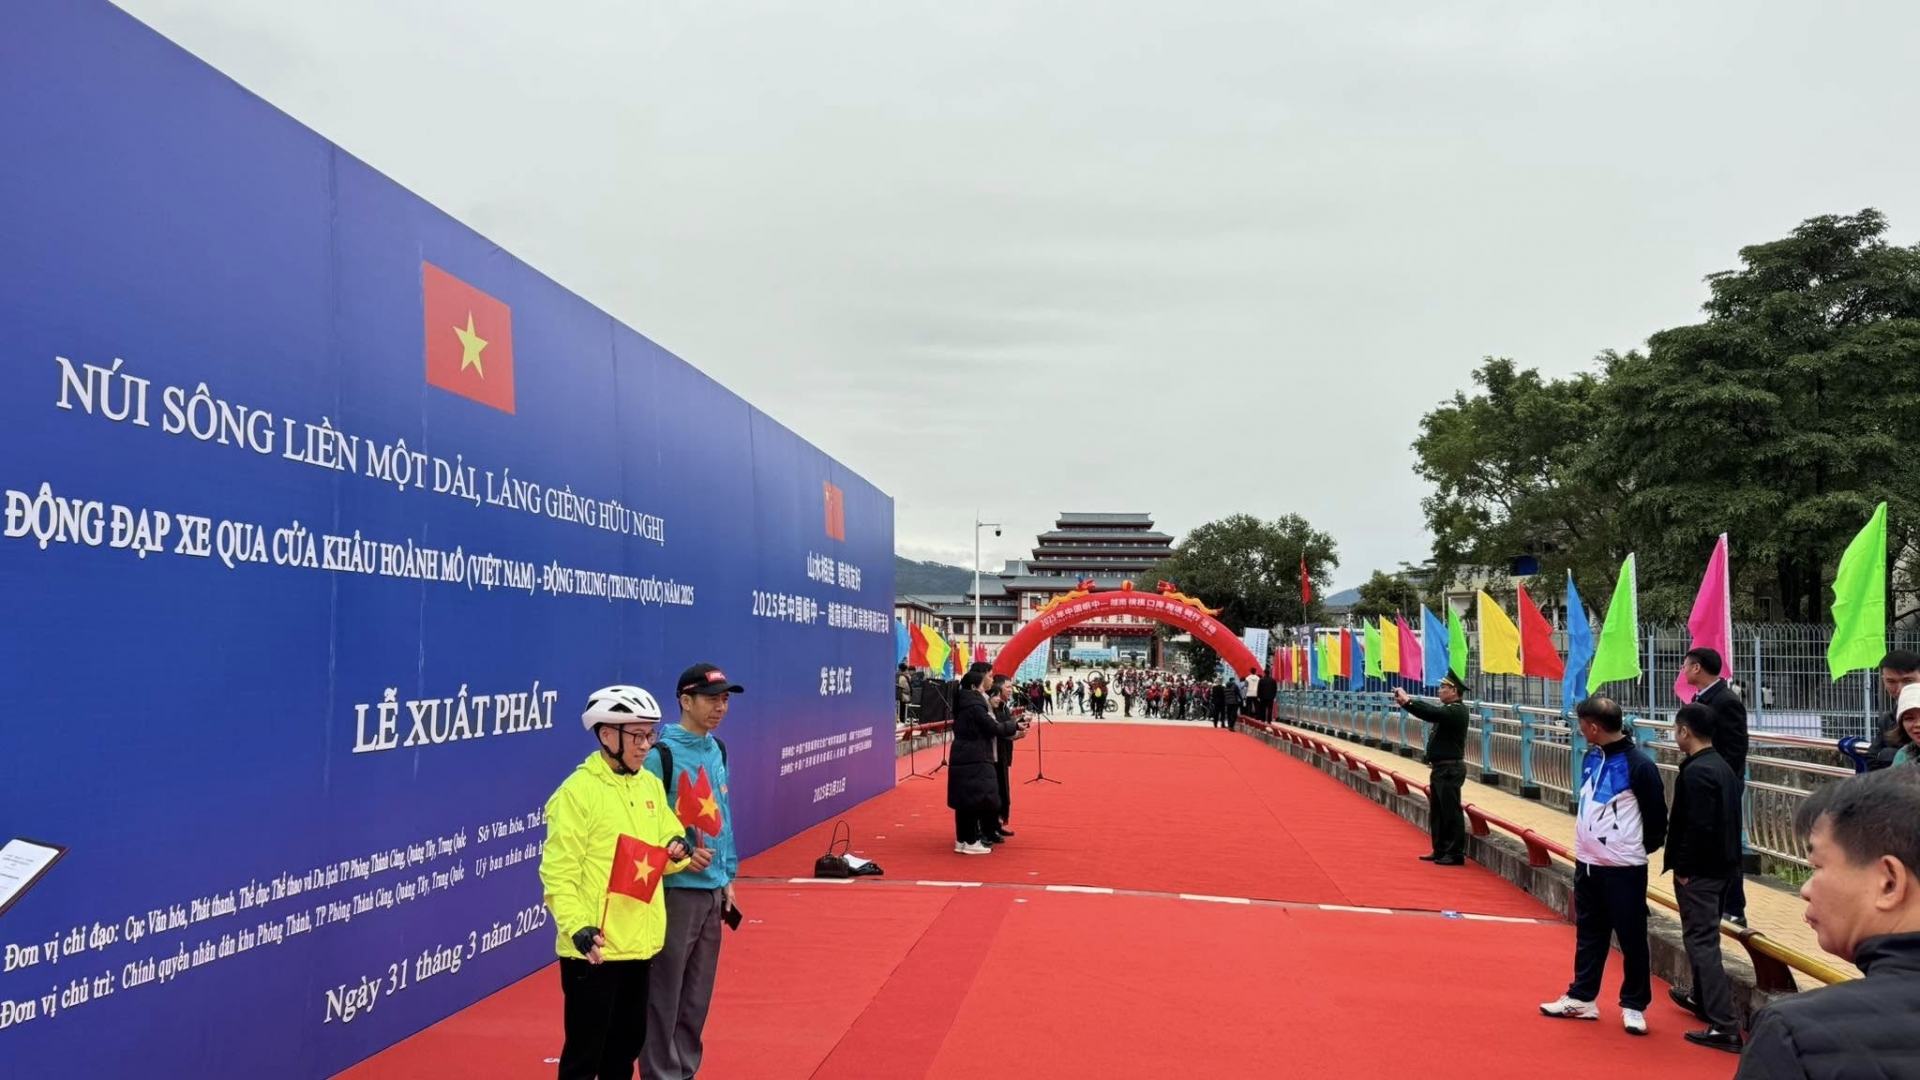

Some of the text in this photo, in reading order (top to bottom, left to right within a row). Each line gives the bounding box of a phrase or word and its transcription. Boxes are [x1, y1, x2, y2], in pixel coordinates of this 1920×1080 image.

[56, 356, 664, 546] NÚI SÔNG LIỀN MỘT DẢI, LÁNG GIỀNG HỮU NGHỊ
[4, 482, 105, 550] ĐỘNG
[110, 504, 170, 559] ĐẠP
[174, 514, 212, 557] XE
[216, 520, 268, 569] QUA
[272, 520, 318, 568] CỬA
[322, 529, 377, 574] KHẨU
[379, 538, 438, 580] HOÀNH
[440, 545, 464, 583] MÔ
[467, 552, 501, 591] (VIỆT
[503, 559, 535, 596] NAM)
[543, 559, 574, 597] ĐỘNG
[574, 569, 607, 598] TRUNG
[607, 573, 639, 603] (TRUNG
[639, 574, 664, 608] QUỐC)
[664, 578, 680, 605] NĂM
[680, 585, 694, 606] 2025
[352, 680, 558, 753] LỄ XUẤT PHÁT
[819, 666, 852, 696] 发车仪式
[477, 825, 490, 844] Sở
[492, 820, 508, 839] Văn
[508, 816, 525, 834] hóa,
[489, 855, 503, 872] ban
[505, 847, 522, 866] nhân
[524, 843, 537, 860] dân
[0, 1000, 36, 1029] Đơn
[41, 985, 57, 1018] vị
[61, 977, 89, 1009] chủ
[93, 970, 115, 999] trì:
[121, 956, 155, 989] Chính
[158, 941, 190, 984] quyền
[191, 938, 216, 967] nhân
[218, 934, 236, 959] dân
[237, 928, 255, 952] khu
[256, 921, 284, 945] Phòng
[315, 905, 327, 927] TP
[327, 900, 351, 923] Phòng
[432, 871, 449, 889] Trung
[450, 859, 464, 886] Quốc
[3, 943, 39, 972] Đơn
[44, 931, 59, 964] vị
[63, 925, 86, 956] chỉ
[89, 921, 119, 951] đạo:
[125, 915, 145, 944] Cục
[147, 909, 167, 935] Văn
[168, 903, 187, 930] hóa,
[190, 898, 210, 923] Phát
[211, 889, 236, 916] thanh,
[239, 878, 255, 910] Thể
[255, 882, 270, 908] dục
[271, 870, 286, 901] Thể
[287, 875, 302, 897] thao
[303, 870, 313, 892] và
[313, 868, 324, 889] Du
[325, 863, 338, 889] lịch
[340, 861, 349, 882] TP
[438, 837, 453, 855] Trung
[453, 826, 466, 853] Quốc
[323, 903, 548, 1023] Ngày 31 tháng 3 năm 2025
